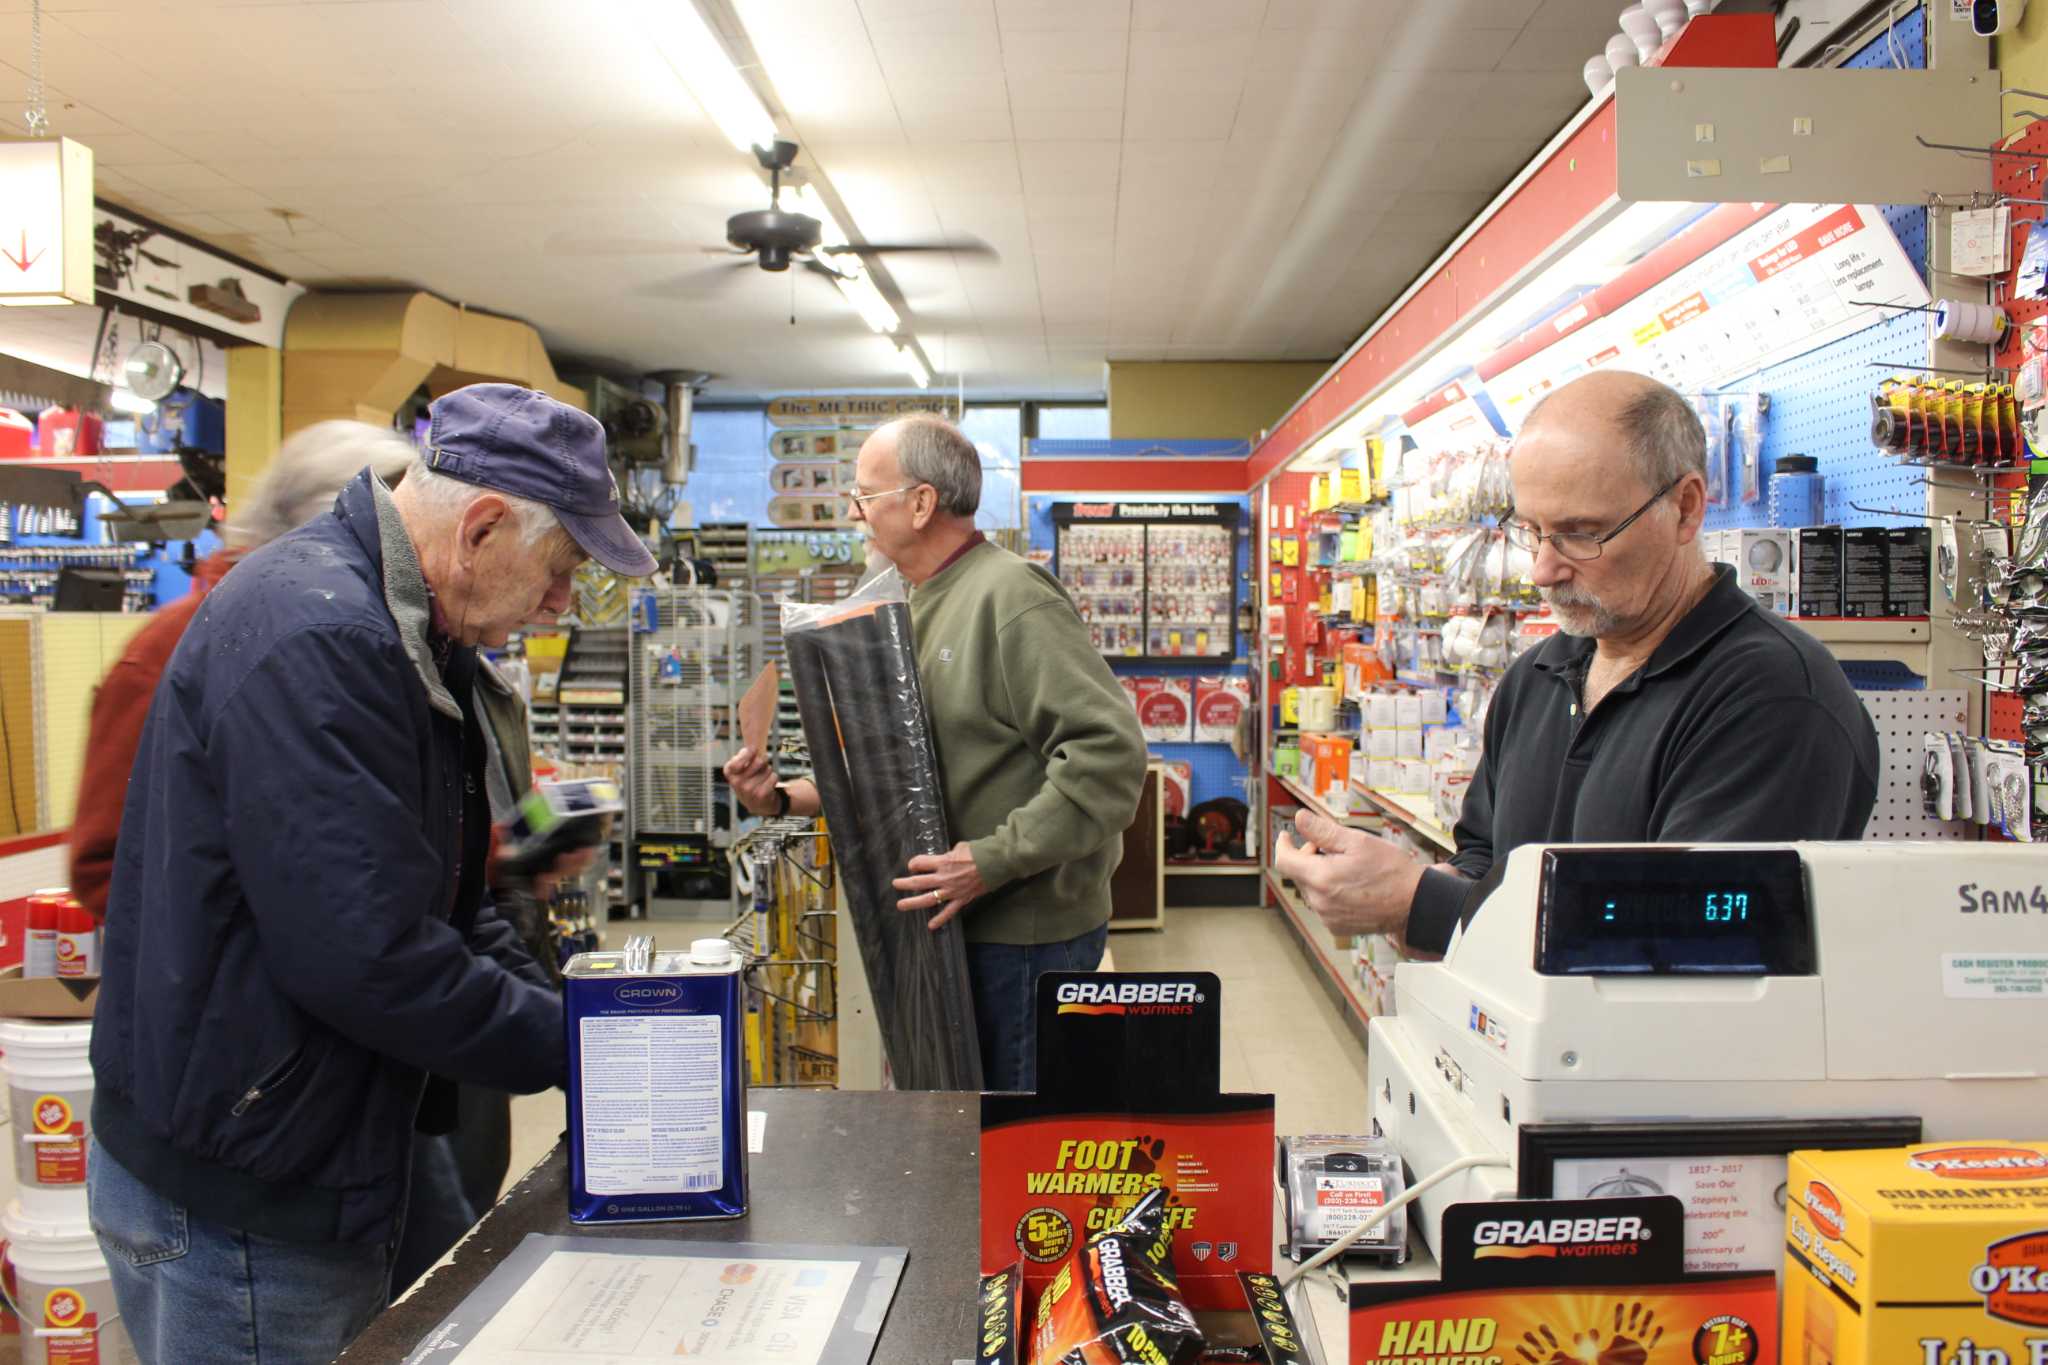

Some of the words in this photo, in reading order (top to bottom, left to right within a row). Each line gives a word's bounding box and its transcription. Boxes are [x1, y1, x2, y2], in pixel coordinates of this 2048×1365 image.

[1834, 258, 1851, 271] Long
[1849, 253, 1862, 264] life
[1832, 276, 1848, 287] Less
[1847, 258, 1885, 282] replacement
[1855, 279, 1874, 292] lamps
[780, 401, 812, 414] The
[817, 400, 889, 414] METRIC
[1171, 505, 1190, 516] the
[1751, 578, 1767, 586] LED
[1976, 959, 2014, 968] REGISTER
[619, 988, 677, 998] CROWN
[1056, 983, 1197, 1005] GRABBER
[1127, 1004, 1194, 1016] warmers
[1056, 1140, 1138, 1170] FOOT
[1688, 1166, 1711, 1174] 1817
[1721, 1165, 1743, 1173] 2017
[1027, 1173, 1162, 1194] WARMERS
[1695, 1181, 1716, 1189] Save
[1719, 1180, 1736, 1189] Our
[1691, 1196, 1728, 1206] Stepney
[1730, 1196, 1737, 1204] is
[1685, 1210, 1730, 1221] elebrating
[1732, 1209, 1748, 1217] the
[1028, 1216, 1061, 1242] 5+
[1473, 1217, 1643, 1245] GRABBER
[1146, 1242, 1166, 1264] 10
[1559, 1242, 1639, 1257] warmers
[1685, 1246, 1733, 1256] nniversary
[1735, 1245, 1745, 1253] of
[1791, 1216, 1810, 1251] Lip
[1814, 1236, 1857, 1286] Repair
[1702, 1260, 1739, 1271] Stepney
[1098, 1238, 1132, 1310] GRABBER
[711, 1288, 735, 1318] CHASE
[1126, 1322, 1147, 1351] 10
[1378, 1318, 1497, 1356] HAND
[1711, 1323, 1748, 1355] 7+
[1708, 1352, 1745, 1365] hours
